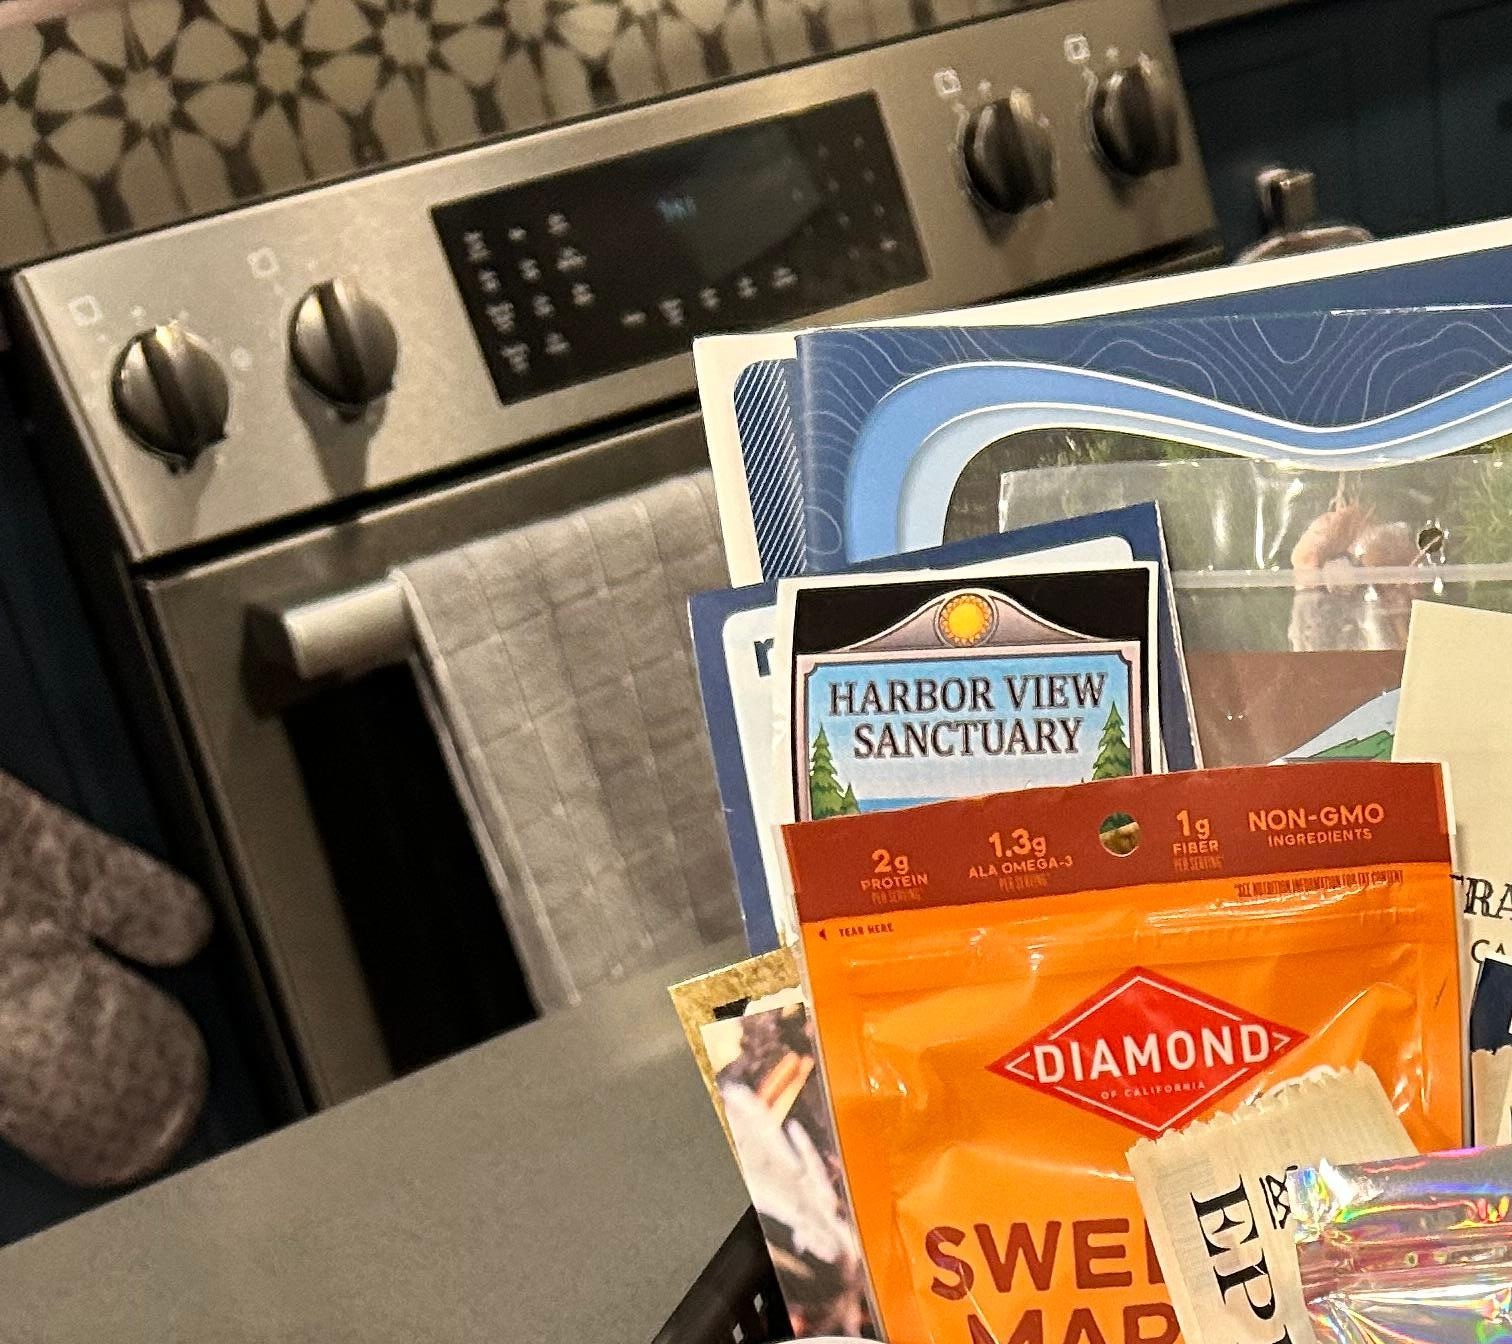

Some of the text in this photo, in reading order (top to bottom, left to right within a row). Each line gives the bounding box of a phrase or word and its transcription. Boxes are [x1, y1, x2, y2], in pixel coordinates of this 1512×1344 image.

[828, 671, 1109, 717] HARBOR VIEW
[853, 716, 1085, 760] SANCTUARY
[1176, 809, 1211, 840] 1g
[1248, 803, 1385, 832] NON-GMO
[988, 828, 1047, 857] 1.3g
[1172, 839, 1220, 856] FIBER
[1268, 828, 1373, 847] INGREDIENTS
[871, 848, 910, 875] 2g
[968, 855, 1074, 879] ALA OMEGA-3
[860, 873, 929, 892] PROTEIN
[839, 922, 894, 938] TEAR HERE
[1033, 1023, 1271, 1084] DIAMOND
[1124, 1081, 1206, 1099] CALIFORNIA
